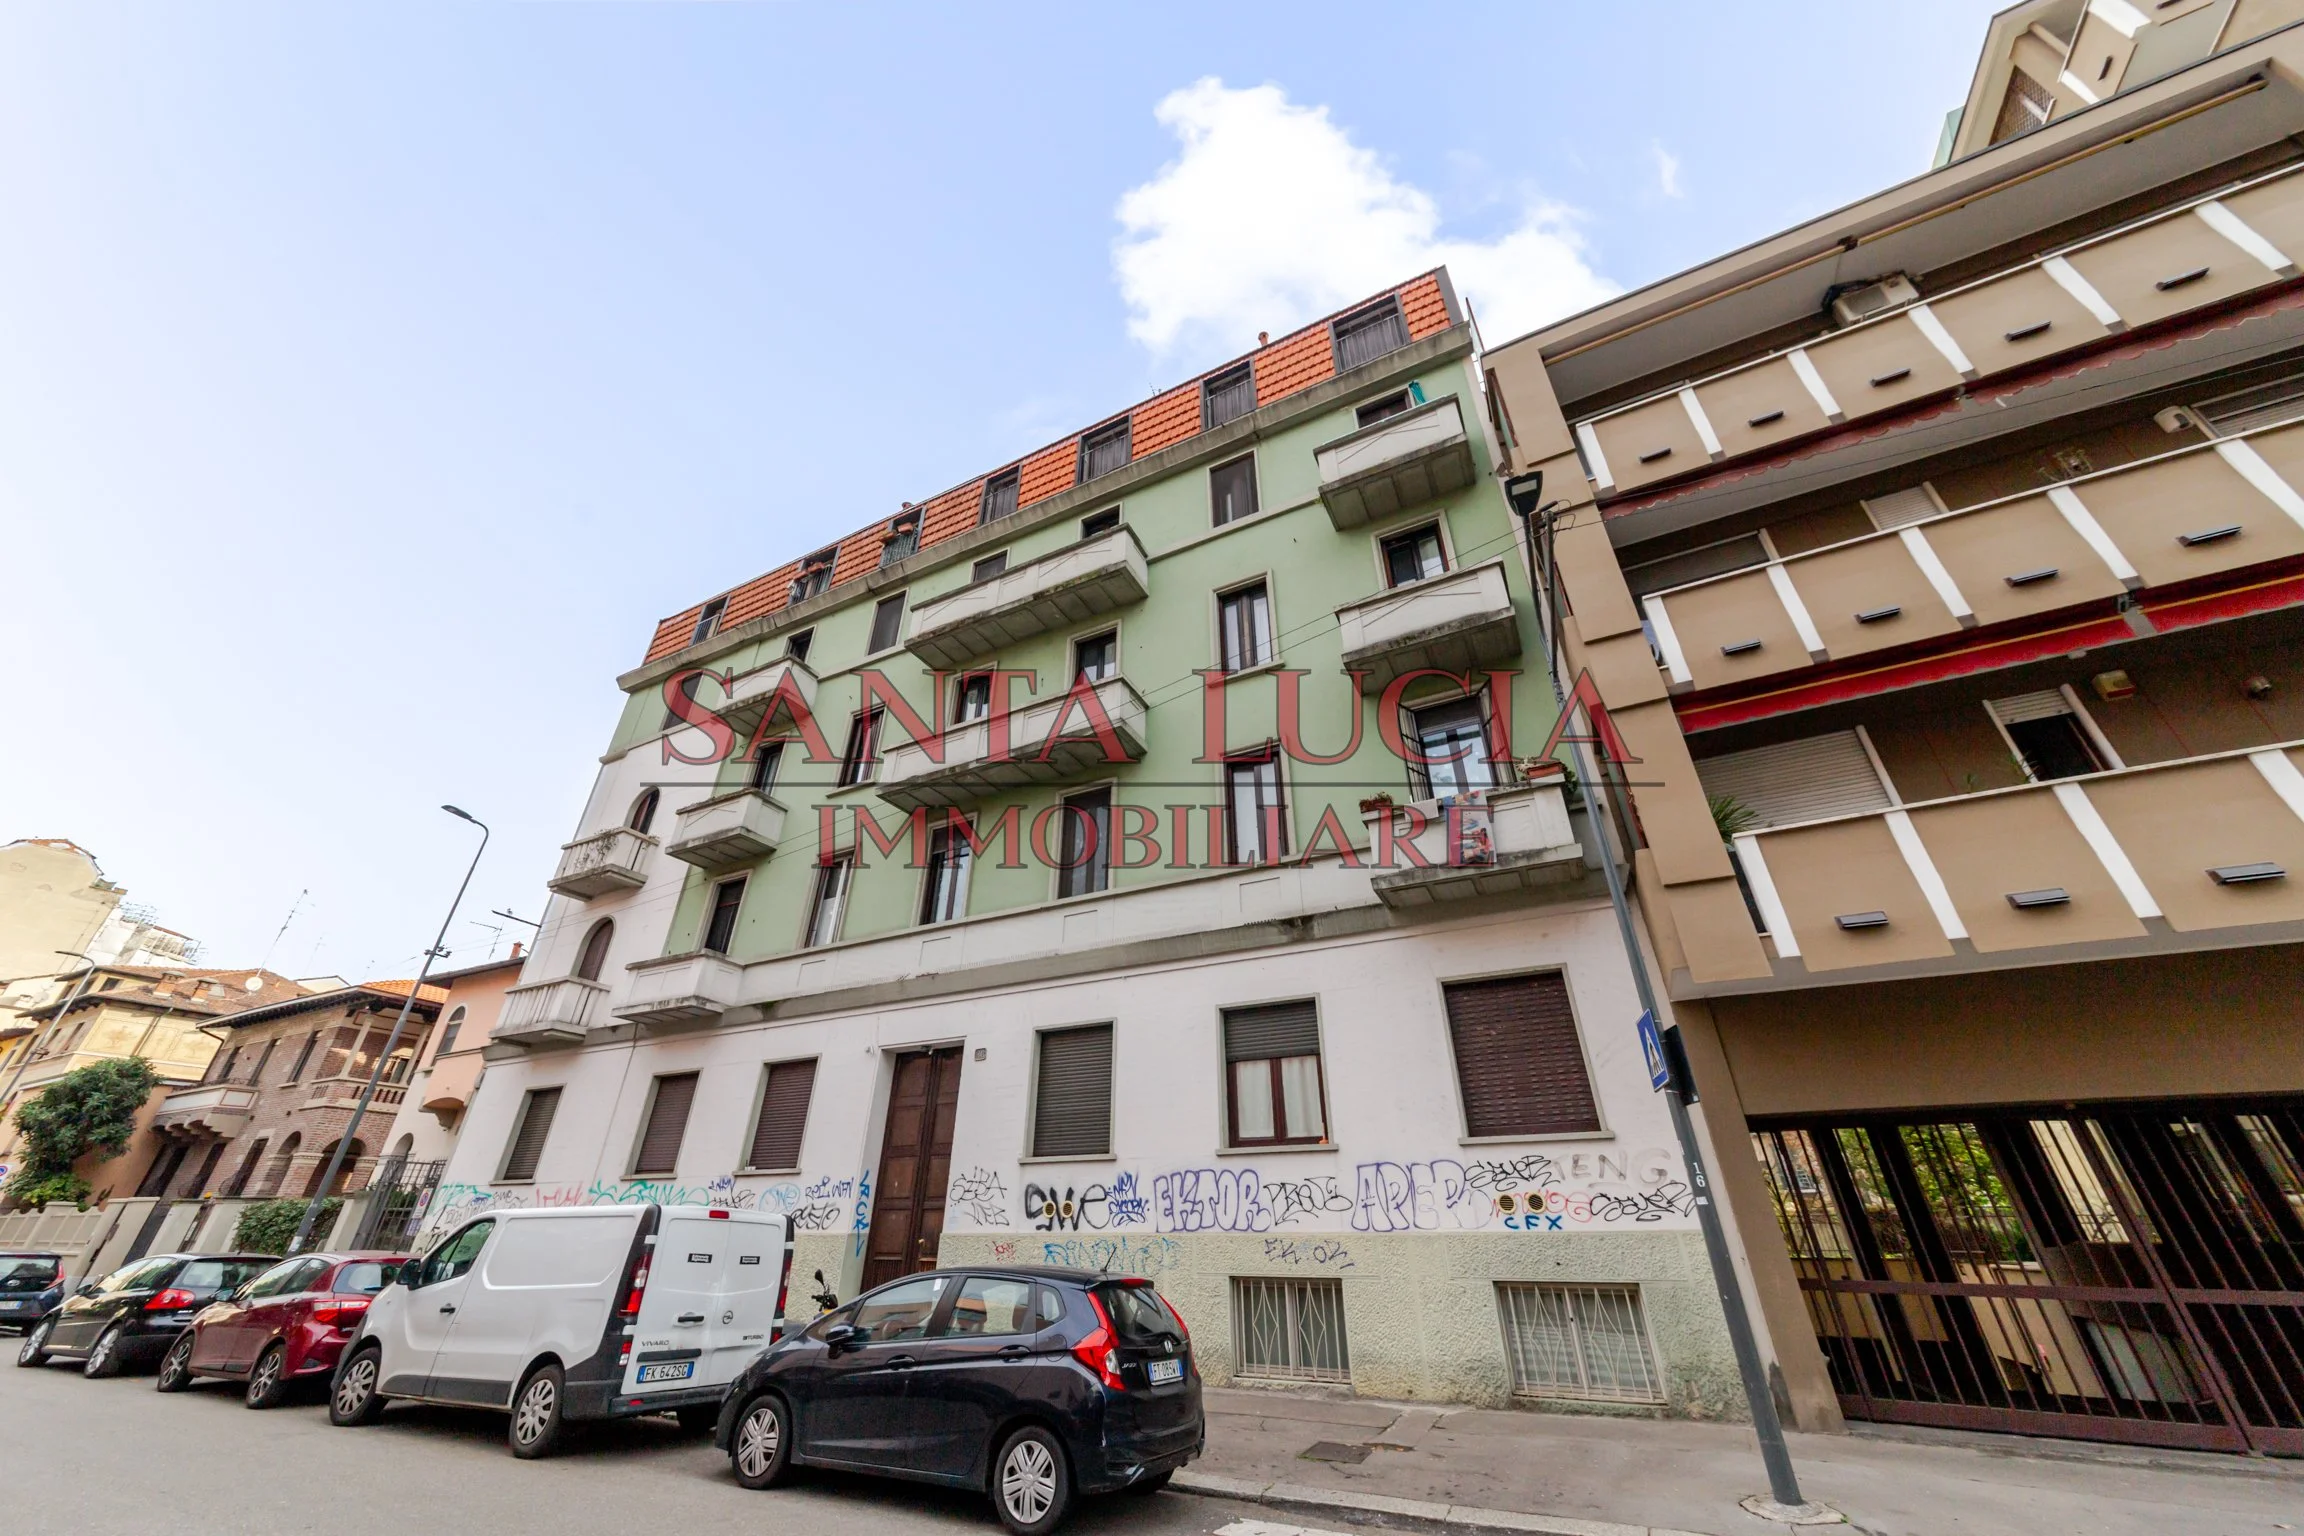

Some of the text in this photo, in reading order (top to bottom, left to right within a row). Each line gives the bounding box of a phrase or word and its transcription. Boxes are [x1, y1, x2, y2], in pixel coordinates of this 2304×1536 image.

[1153, 1168, 1272, 1233] EKTOR
[1504, 1215, 1562, 1230] CFX
[645, 1367, 656, 1380] FK
